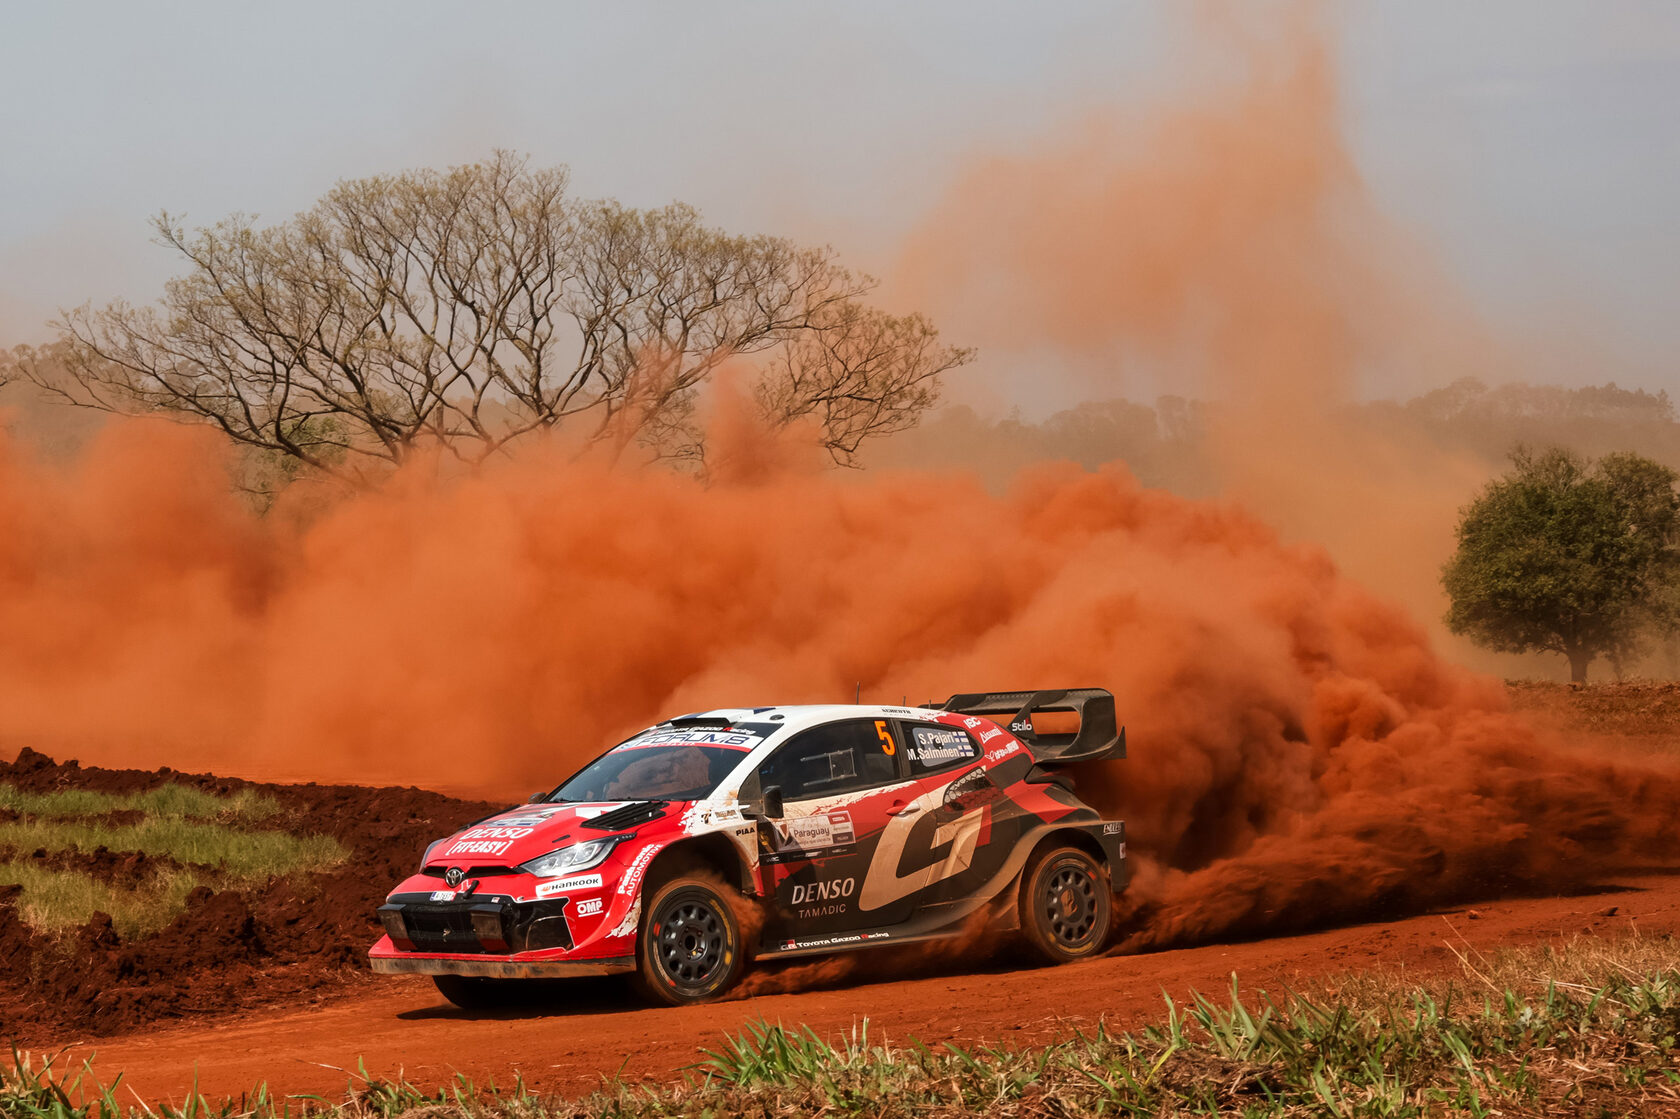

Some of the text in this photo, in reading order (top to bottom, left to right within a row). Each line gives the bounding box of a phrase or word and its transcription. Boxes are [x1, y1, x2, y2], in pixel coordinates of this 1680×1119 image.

[1012, 719, 1032, 731] Stilo
[874, 720, 896, 756] 5
[918, 732, 954, 745] S.Pajari
[907, 747, 960, 761] M.Salminen
[460, 827, 534, 840] DENSO
[736, 827, 755, 836] PIAA
[794, 828, 830, 838] Paraguay
[626, 844, 664, 896] AUTOMOTIVE
[791, 878, 855, 904] DENSO
[577, 900, 603, 914] OMP
[799, 904, 847, 918] TAMADIC
[796, 940, 831, 948] TOYOTA
[860, 932, 890, 940] Racing
